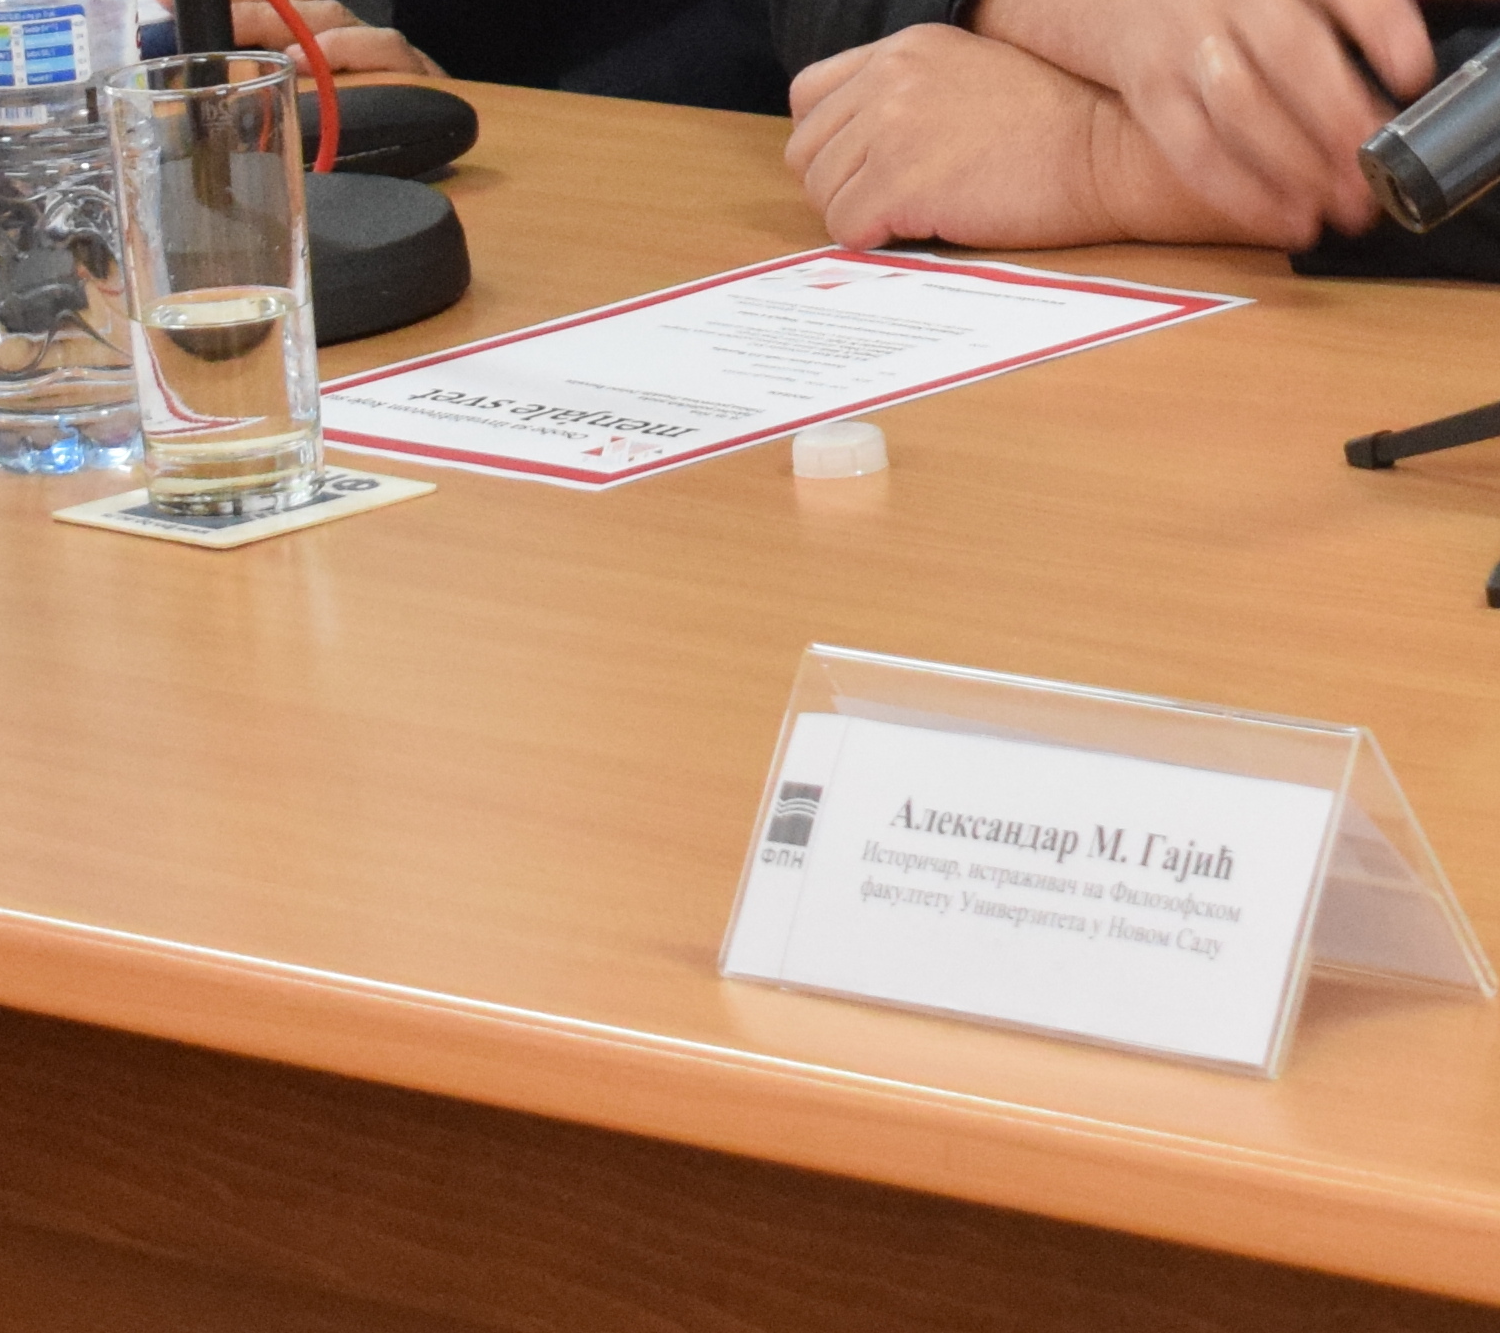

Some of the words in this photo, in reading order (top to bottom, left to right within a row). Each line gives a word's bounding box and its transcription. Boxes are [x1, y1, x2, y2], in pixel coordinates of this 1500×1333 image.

[407, 387, 509, 409] svet
[761, 847, 806, 870] ФПН
[861, 839, 962, 879] Историчар,
[967, 861, 1078, 896] истраживач
[1082, 880, 1104, 900] на
[1108, 880, 1243, 923] Филозофском
[888, 795, 1080, 865] Александар
[1085, 823, 1129, 864] М.
[1137, 831, 1236, 884] Гајић
[859, 874, 953, 915] факултету
[958, 888, 1086, 933] Универзитета
[1107, 914, 1171, 948] Новом
[1174, 926, 1225, 962] Саду
